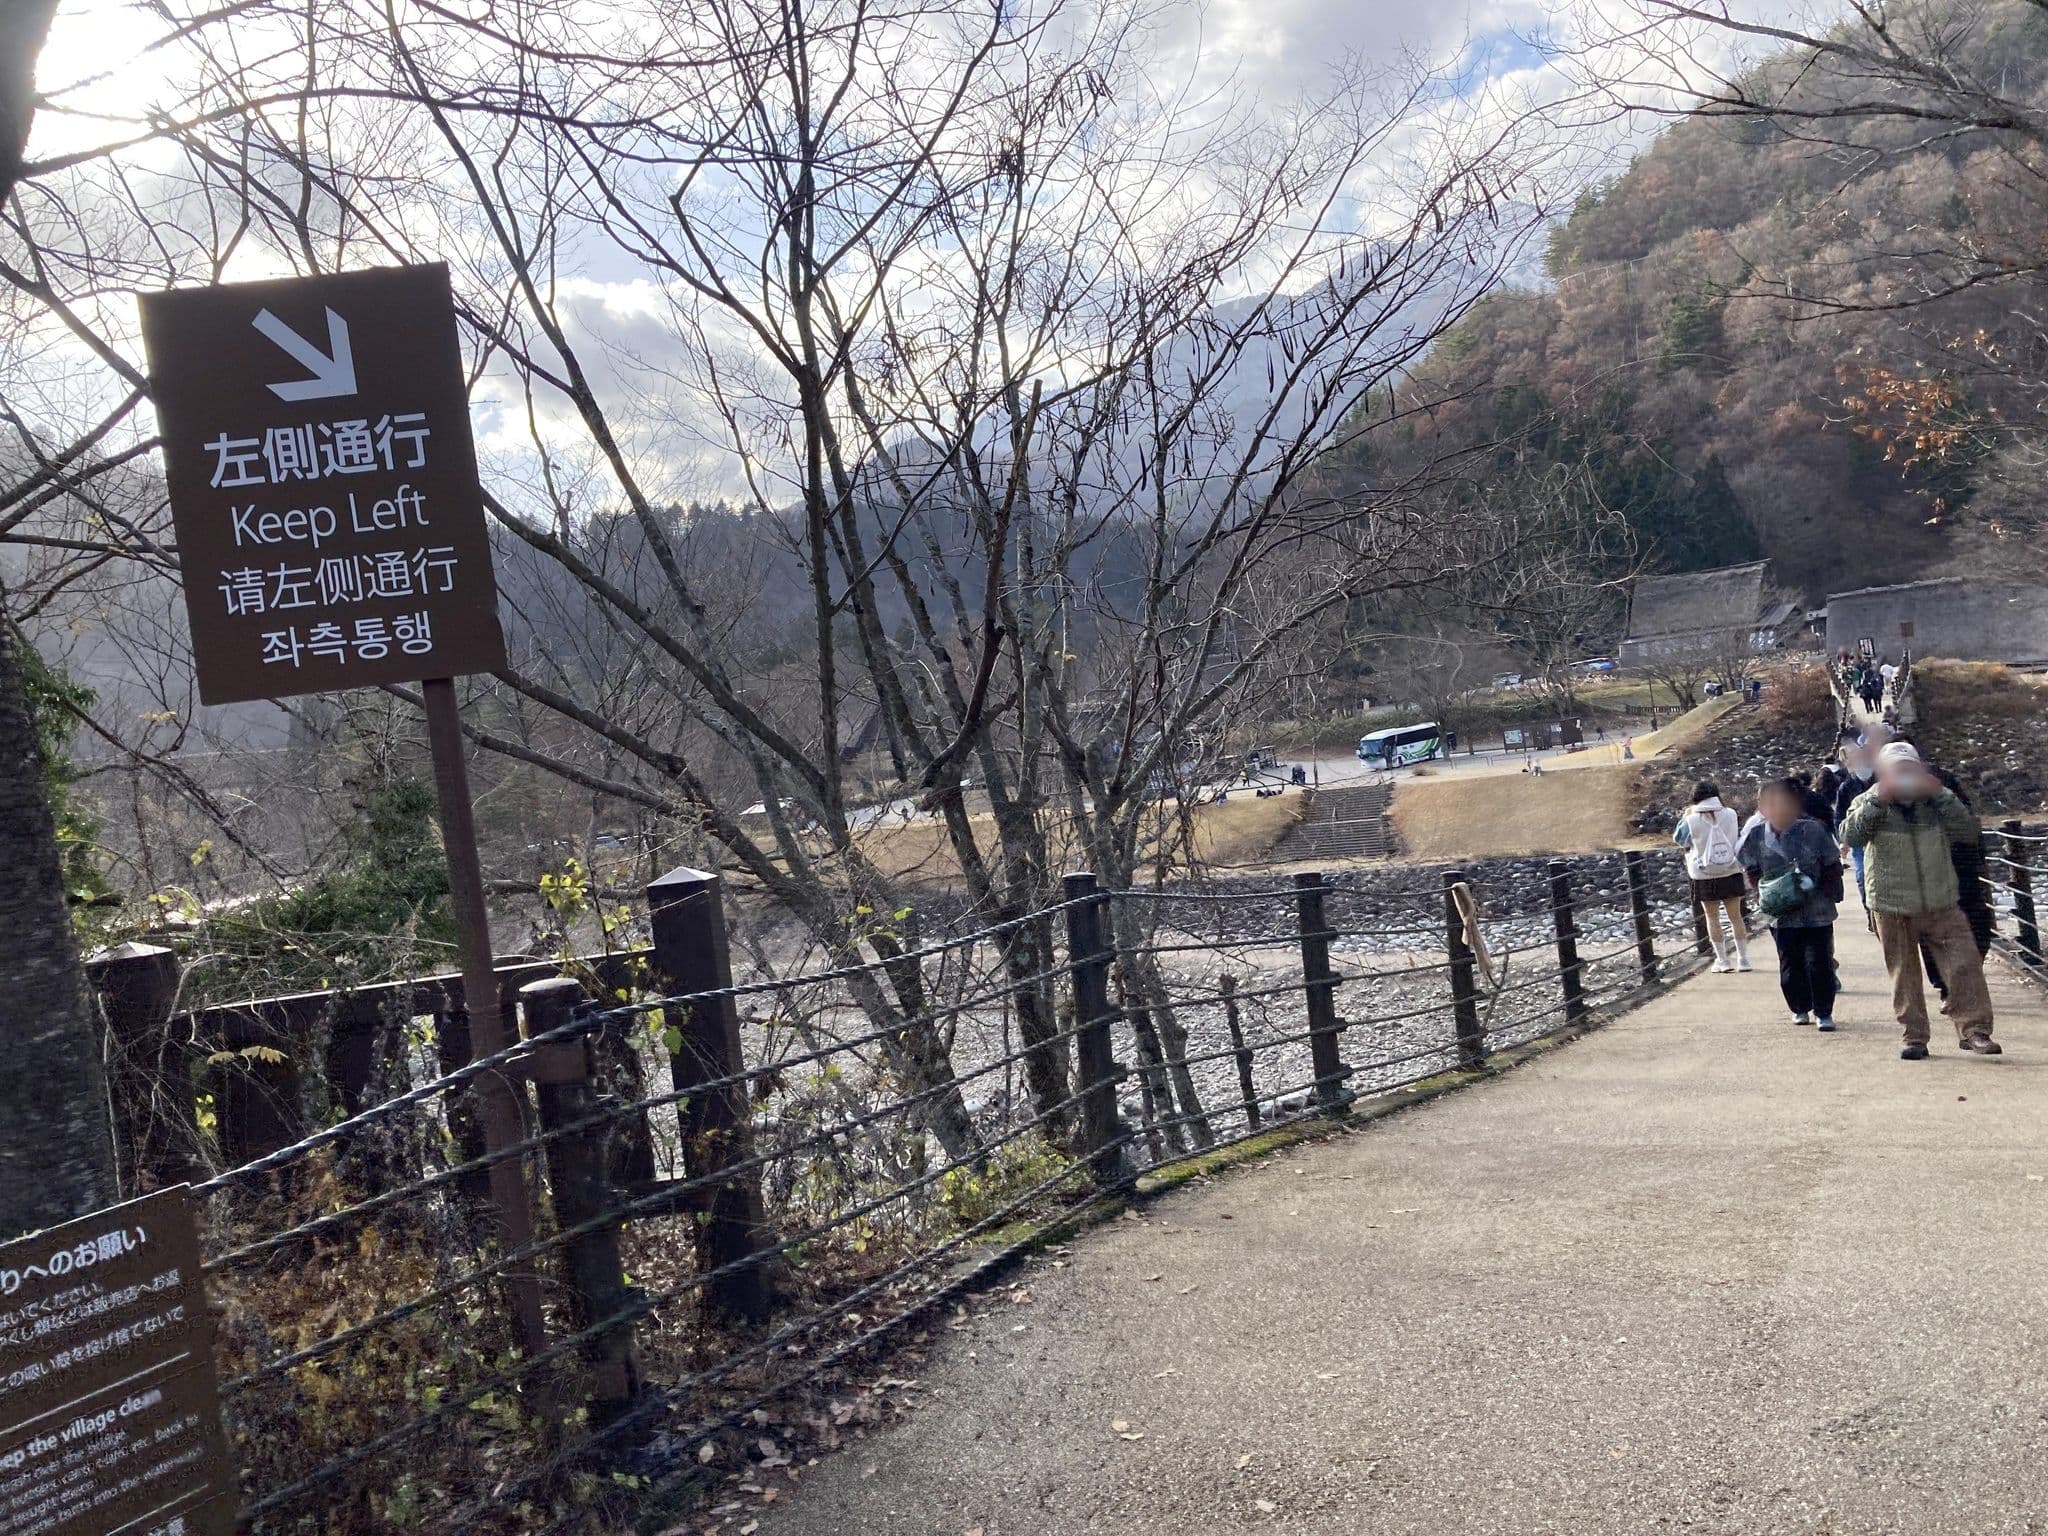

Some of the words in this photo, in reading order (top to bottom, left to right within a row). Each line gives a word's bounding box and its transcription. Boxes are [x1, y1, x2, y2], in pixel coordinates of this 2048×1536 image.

[203, 412, 431, 488] 左側通行
[231, 501, 336, 548] Keep
[348, 484, 429, 533] Left
[218, 546, 458, 616] 请左侧通行
[261, 610, 433, 668] 좌측통행
[27, 1433, 58, 1457] the
[60, 1408, 116, 1442] village
